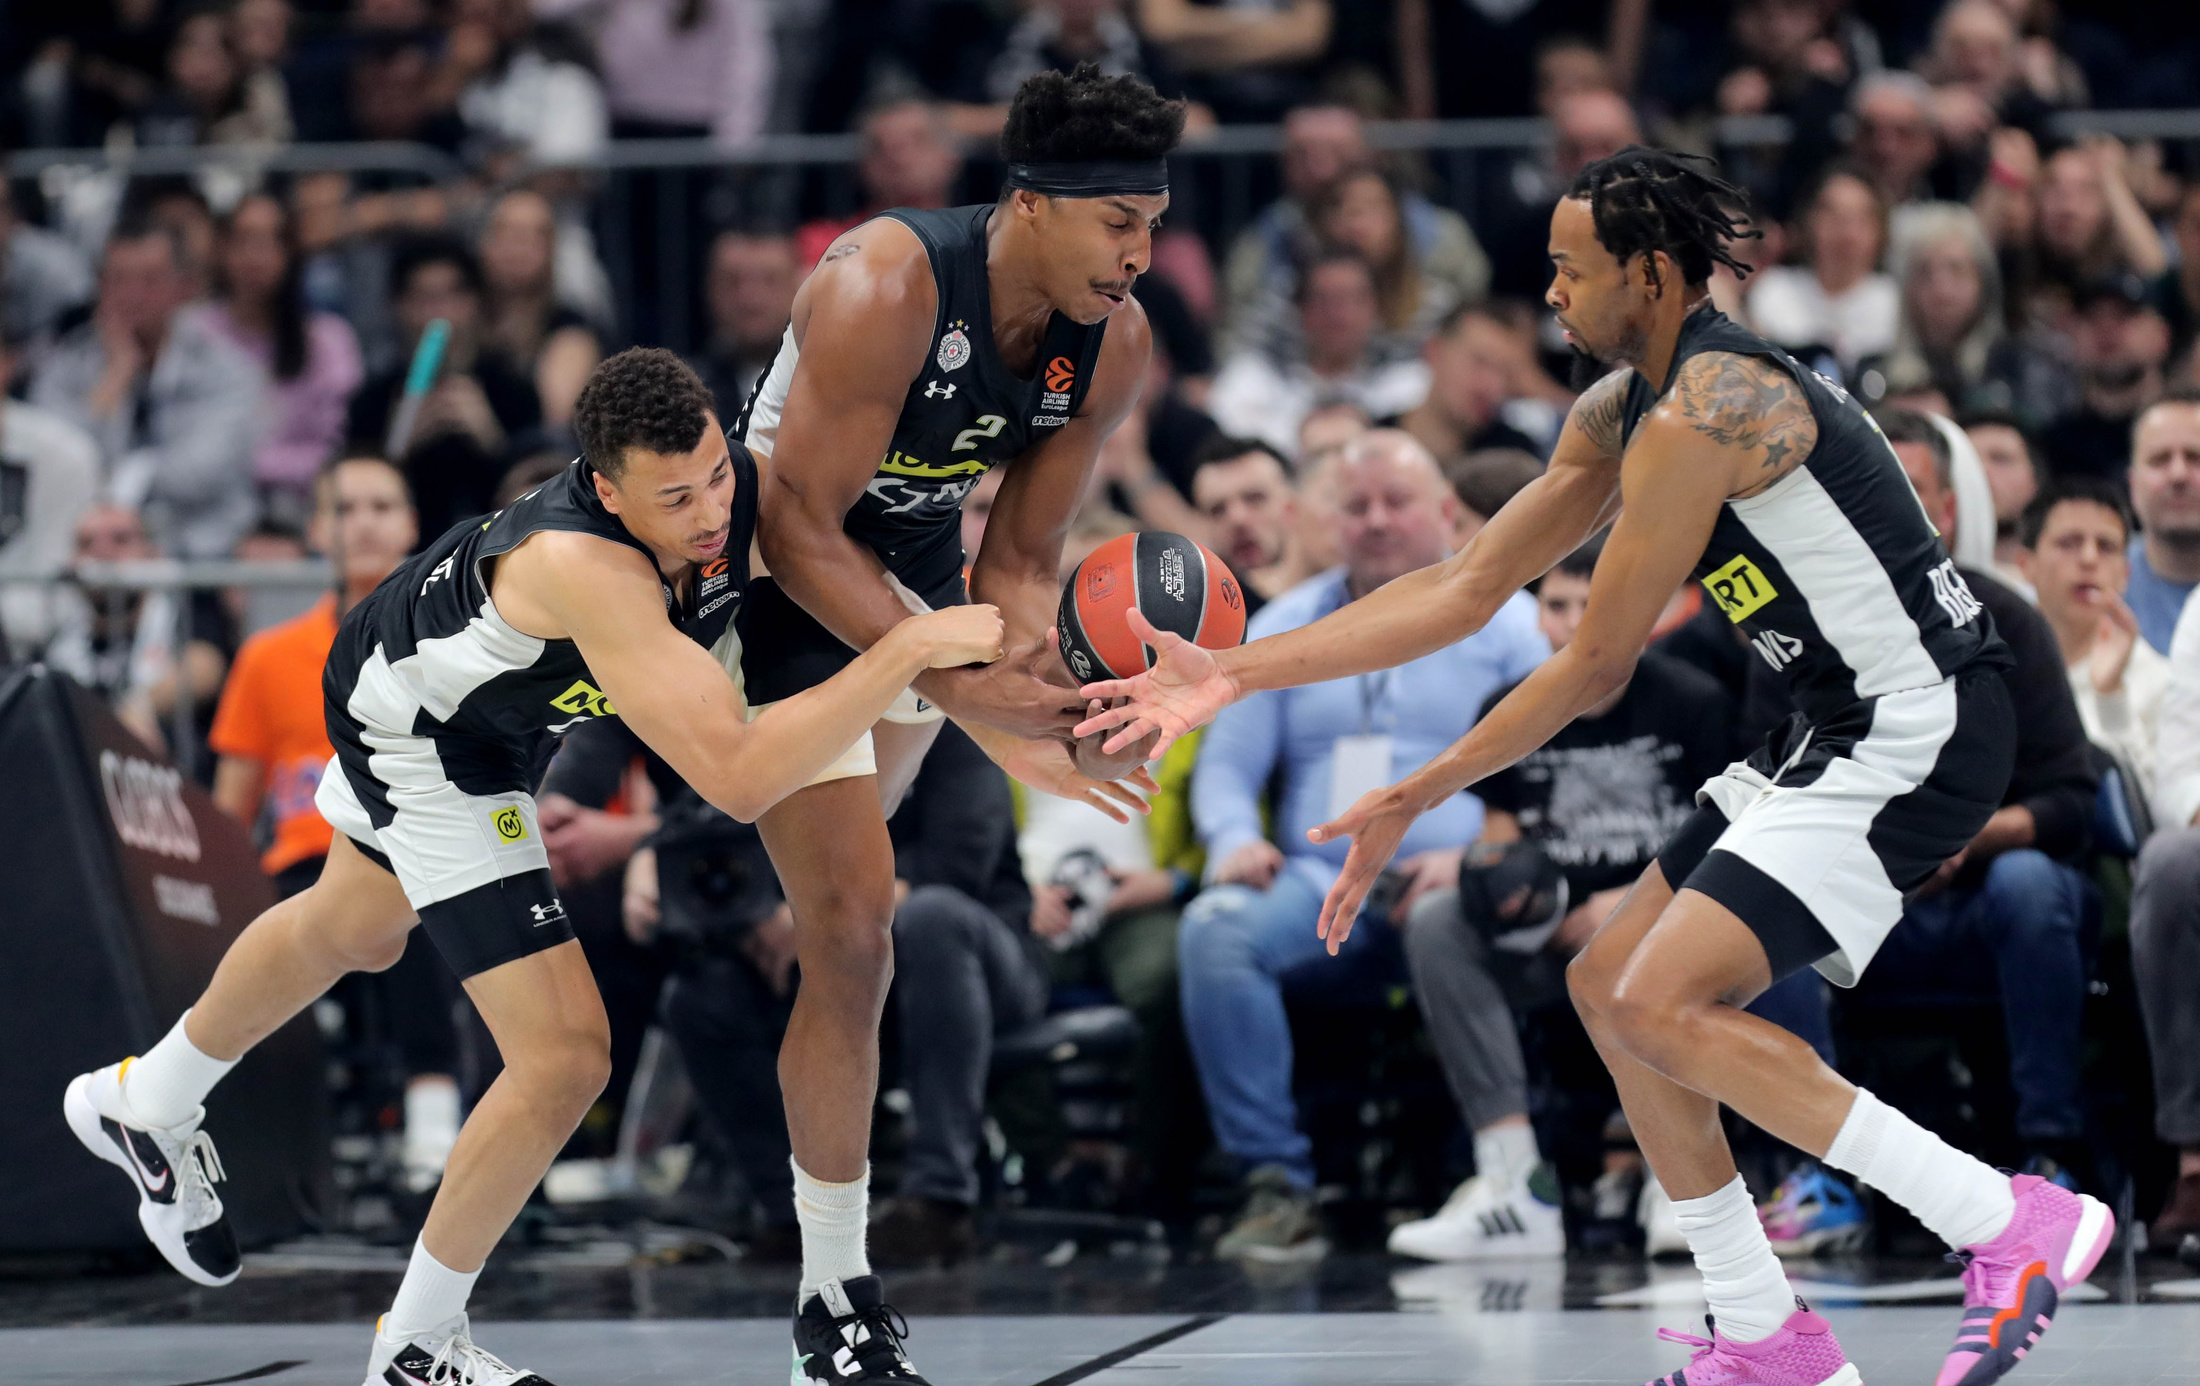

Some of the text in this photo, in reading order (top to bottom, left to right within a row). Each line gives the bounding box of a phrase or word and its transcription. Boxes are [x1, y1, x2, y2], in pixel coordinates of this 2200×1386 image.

[1043, 392, 1071, 400] TURKISH
[1042, 398, 1070, 406] AIRLINES
[951, 414, 1007, 452] 2
